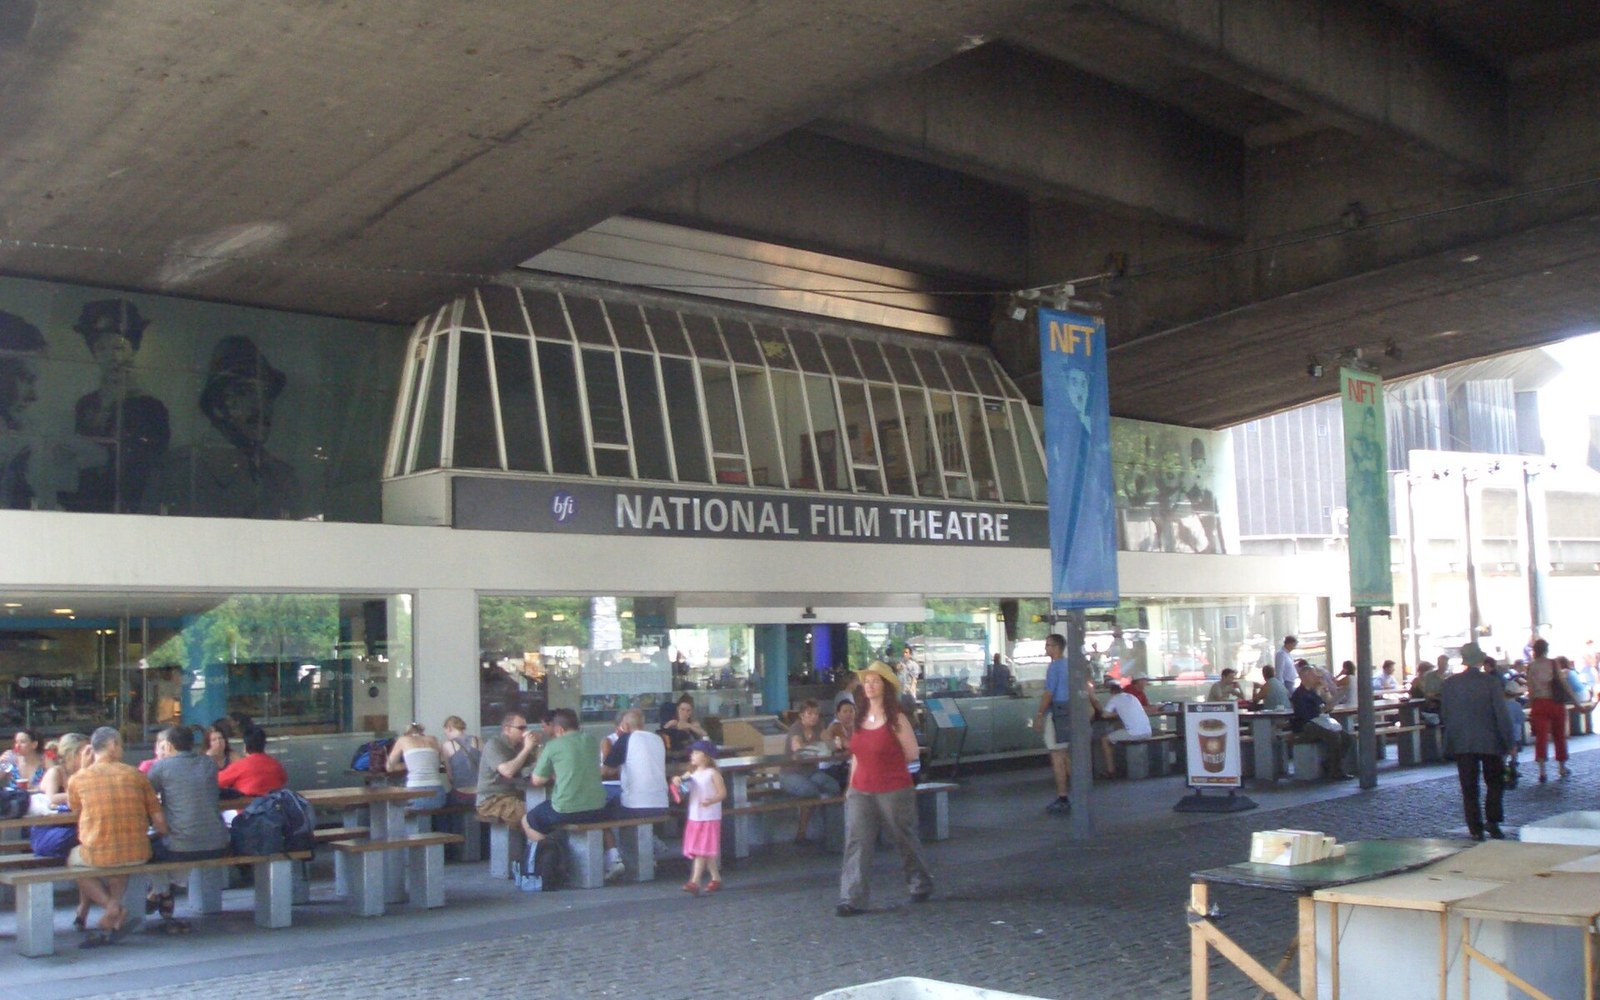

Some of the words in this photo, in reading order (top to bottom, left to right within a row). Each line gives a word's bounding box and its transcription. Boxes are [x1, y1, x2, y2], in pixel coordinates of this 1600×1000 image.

[1050, 321, 1095, 356] NFT
[1348, 377, 1376, 404] NFT
[553, 495, 573, 521] bfi
[616, 493, 799, 534] NATIONAL
[810, 504, 880, 537] FILM
[890, 508, 1010, 542] THEATRE
